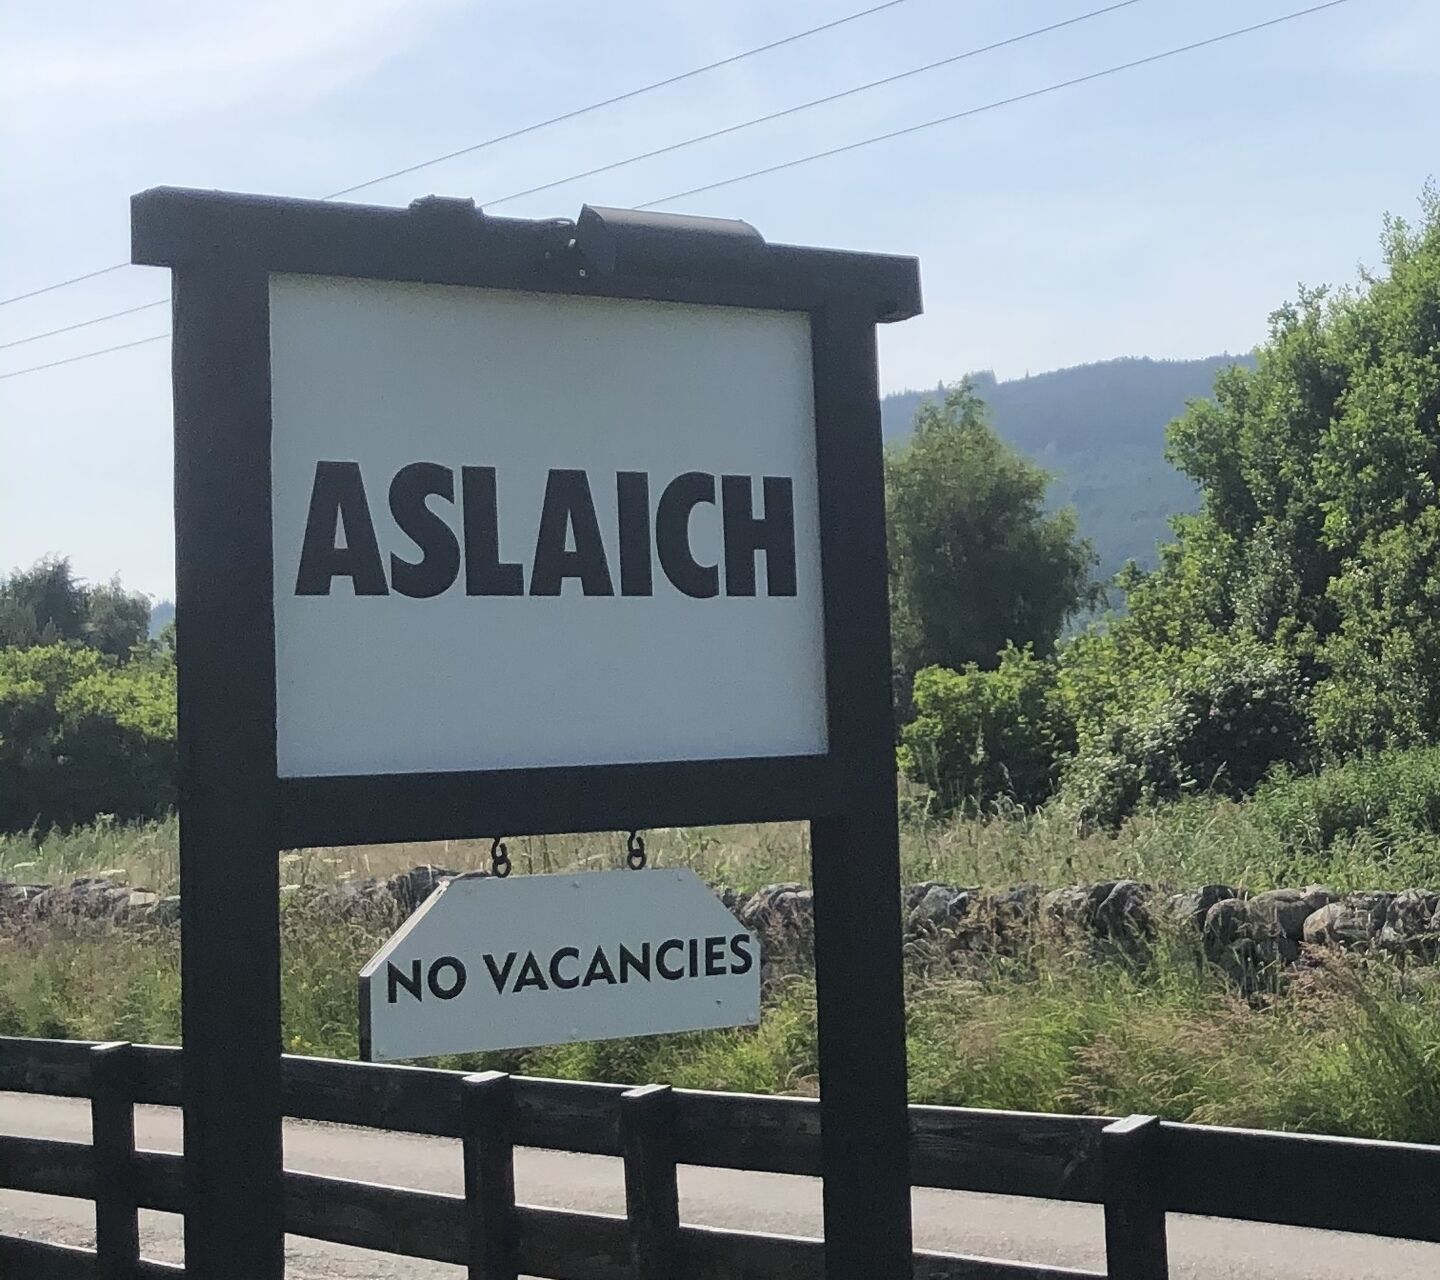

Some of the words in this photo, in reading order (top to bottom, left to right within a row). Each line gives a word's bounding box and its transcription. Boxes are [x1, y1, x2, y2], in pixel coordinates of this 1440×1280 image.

[293, 460, 798, 599] ASLAICH
[386, 955, 468, 1004] NO
[481, 933, 754, 996] VACANCIES
